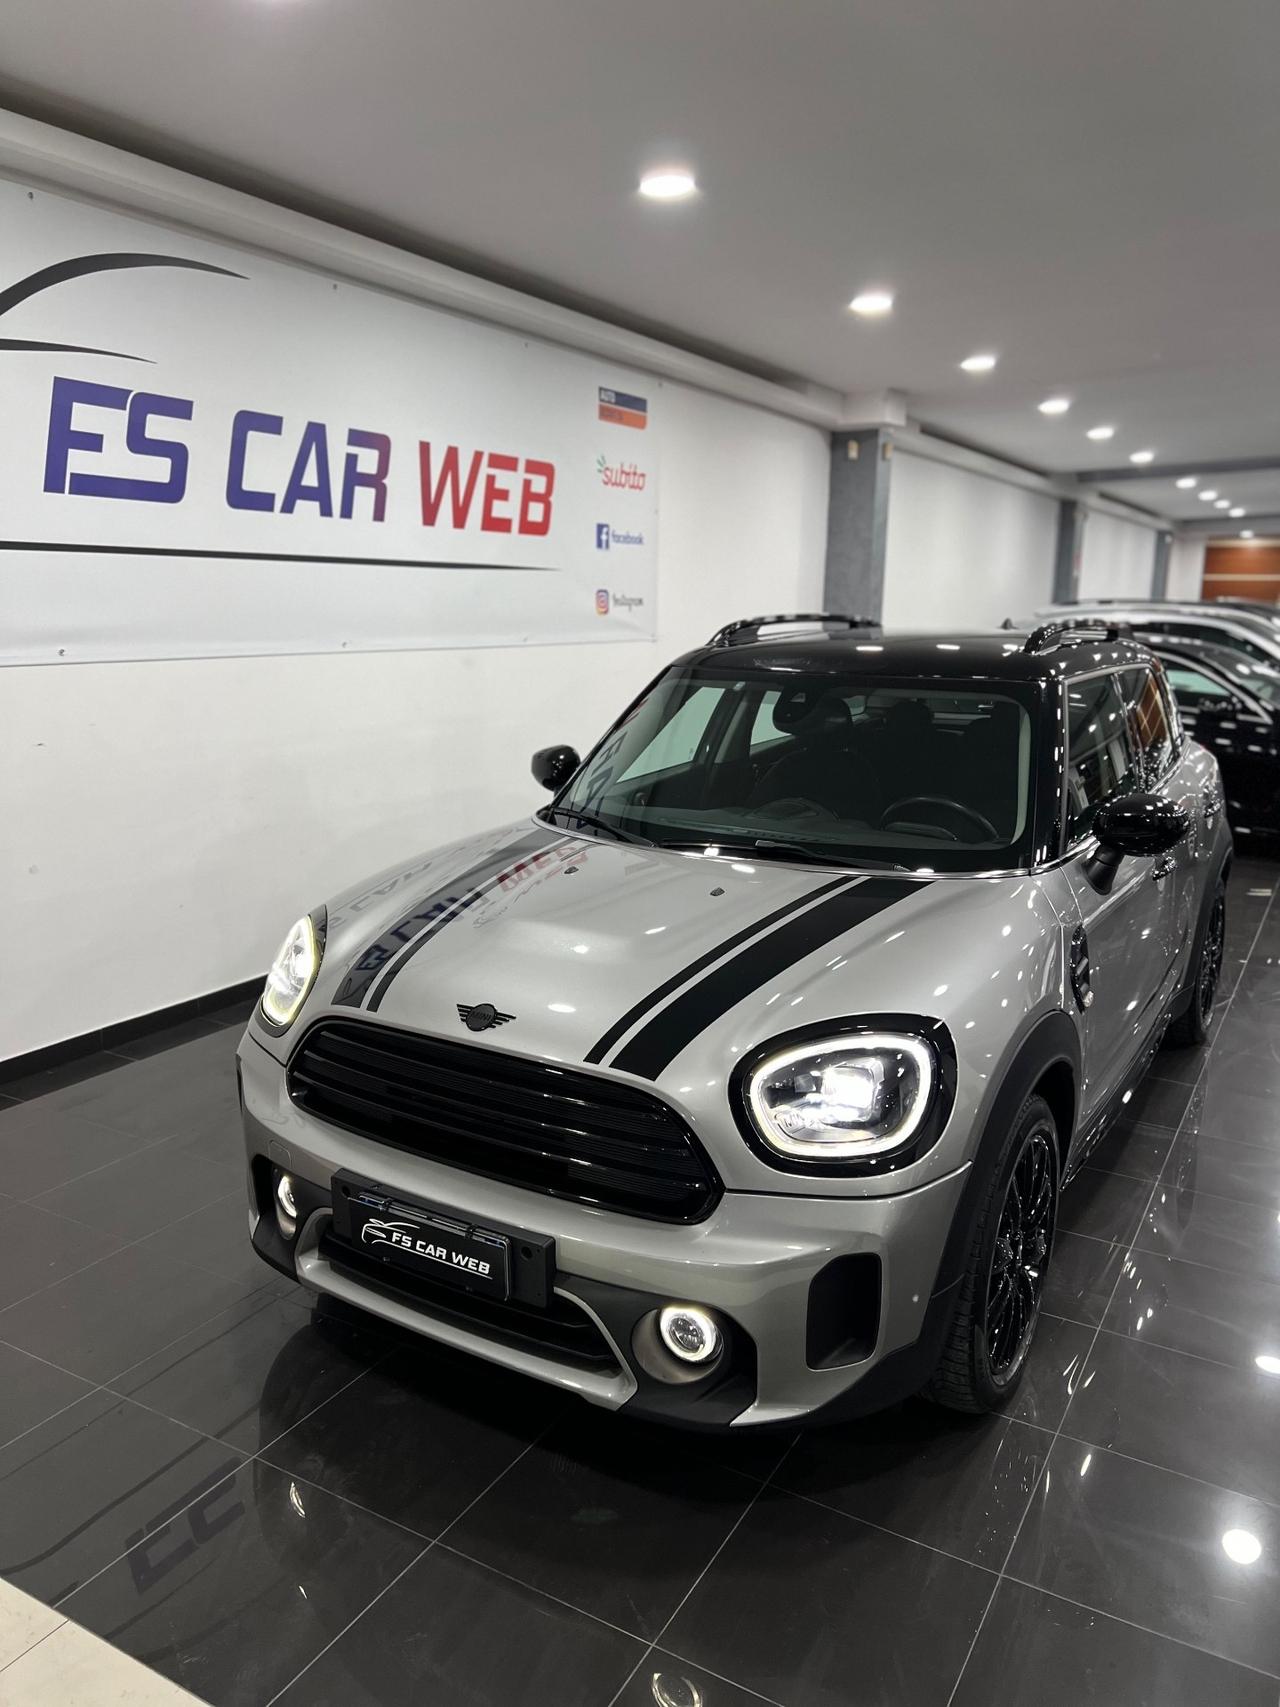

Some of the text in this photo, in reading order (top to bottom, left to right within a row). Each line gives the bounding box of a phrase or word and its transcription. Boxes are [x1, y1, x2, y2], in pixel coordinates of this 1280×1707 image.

[43, 376, 556, 537] FS CAR WEB
[602, 462, 647, 490] subito
[391, 1232, 490, 1275] FS CAR WEB
